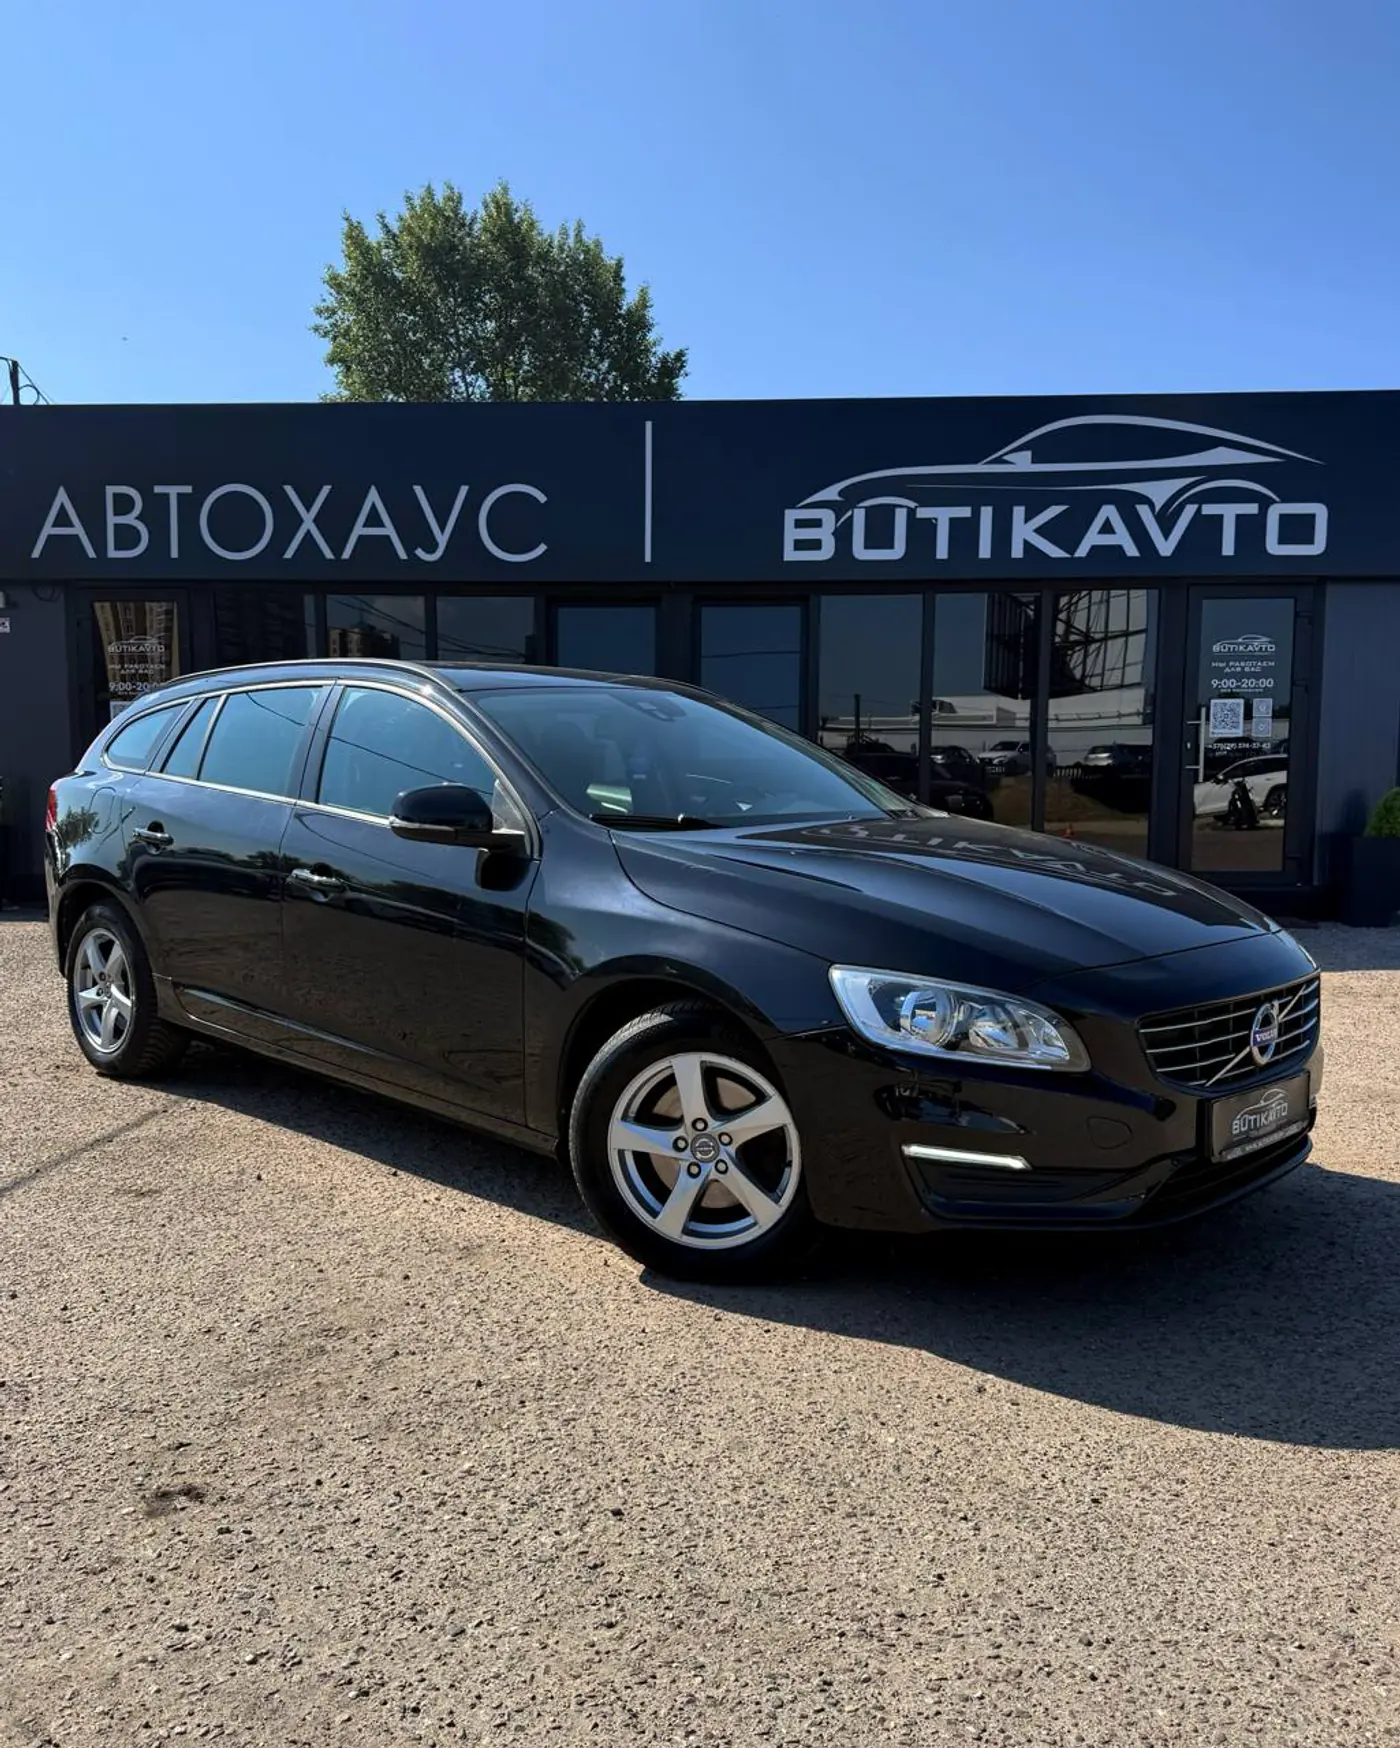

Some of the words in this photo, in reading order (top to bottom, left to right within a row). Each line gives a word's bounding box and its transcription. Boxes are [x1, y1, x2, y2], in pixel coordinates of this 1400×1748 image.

[31, 483, 548, 562] АВТОХАУС
[783, 502, 1328, 561] BUTIKAVTO
[1212, 644, 1276, 653] BUTIKAVTO
[1211, 678, 1274, 688] 9:00-20:00
[1232, 1102, 1288, 1134] BUTIKAVTO
